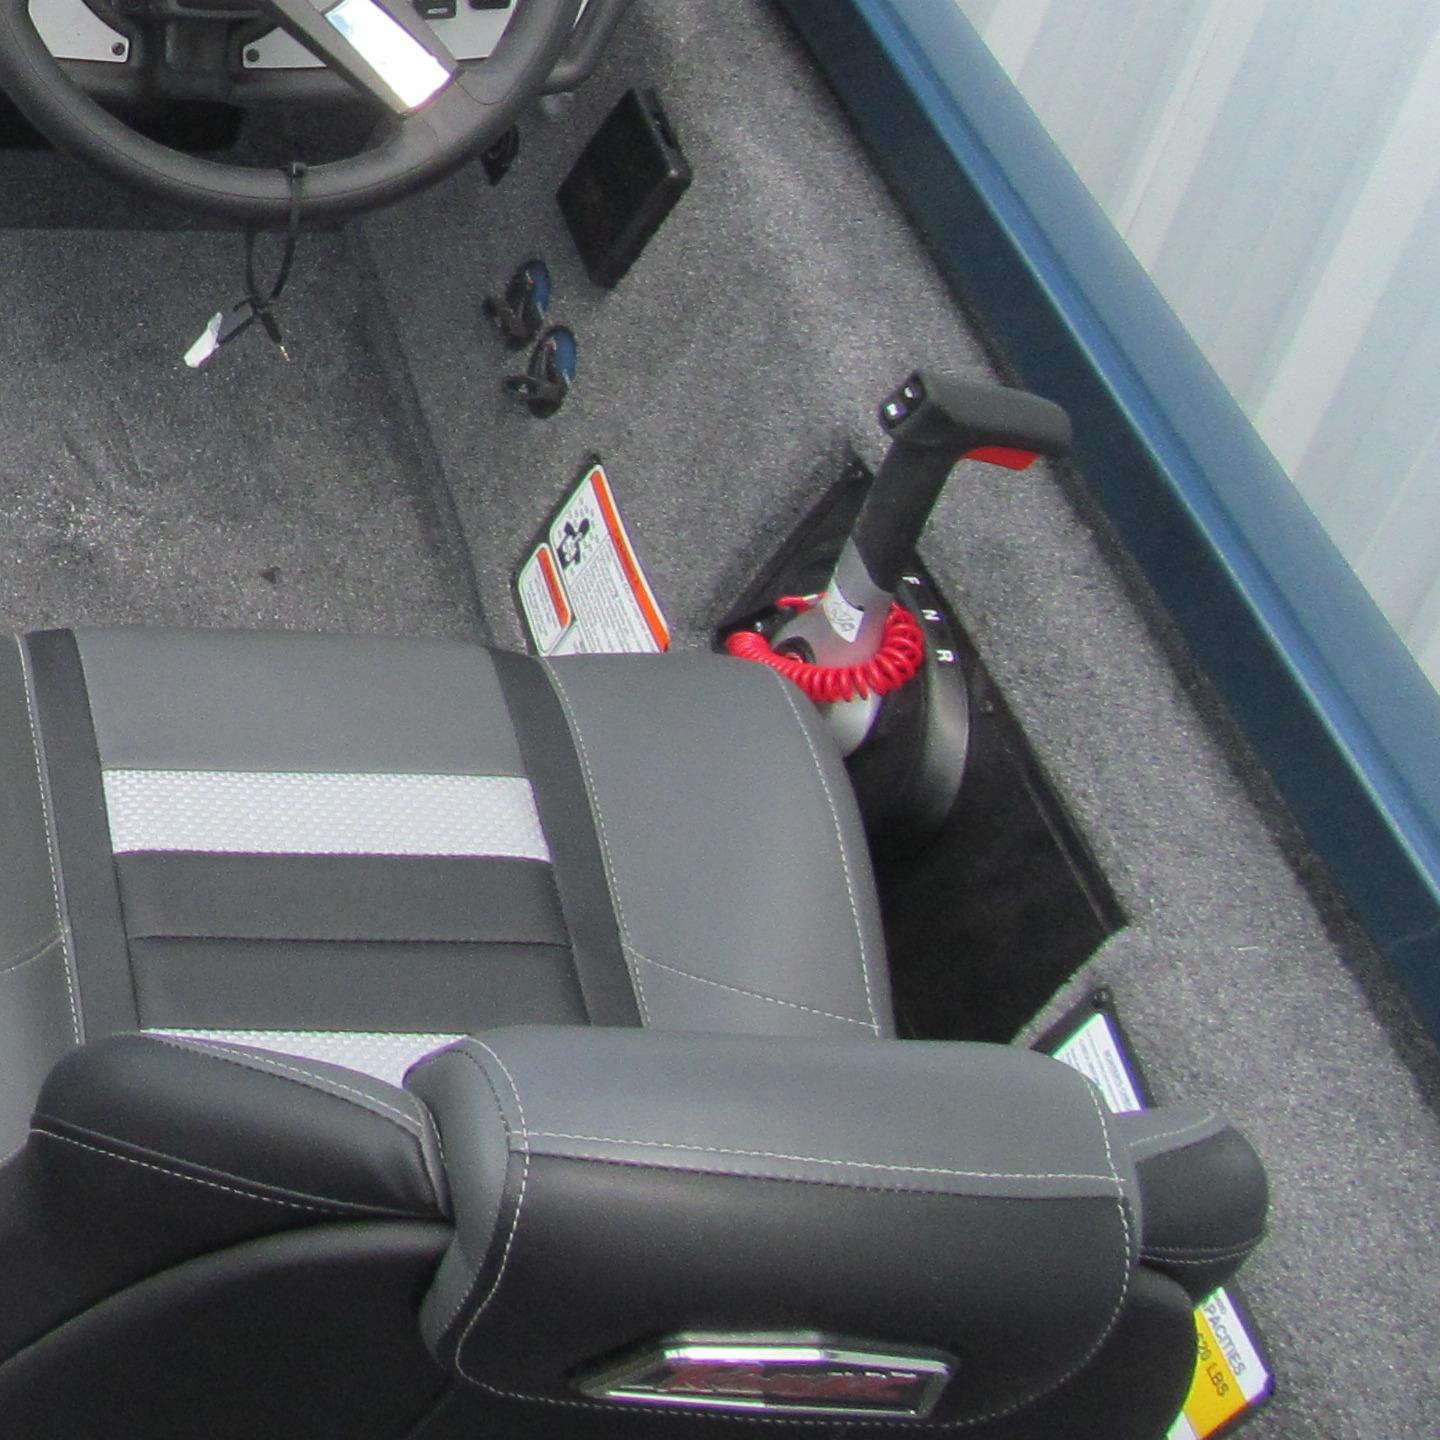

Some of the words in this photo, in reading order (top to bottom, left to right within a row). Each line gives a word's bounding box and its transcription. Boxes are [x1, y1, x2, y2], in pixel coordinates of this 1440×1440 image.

[921, 609, 941, 621] N
[935, 648, 955, 662] R
[1203, 1304, 1247, 1377] PACITIES
[1206, 1361, 1230, 1397] LBS
